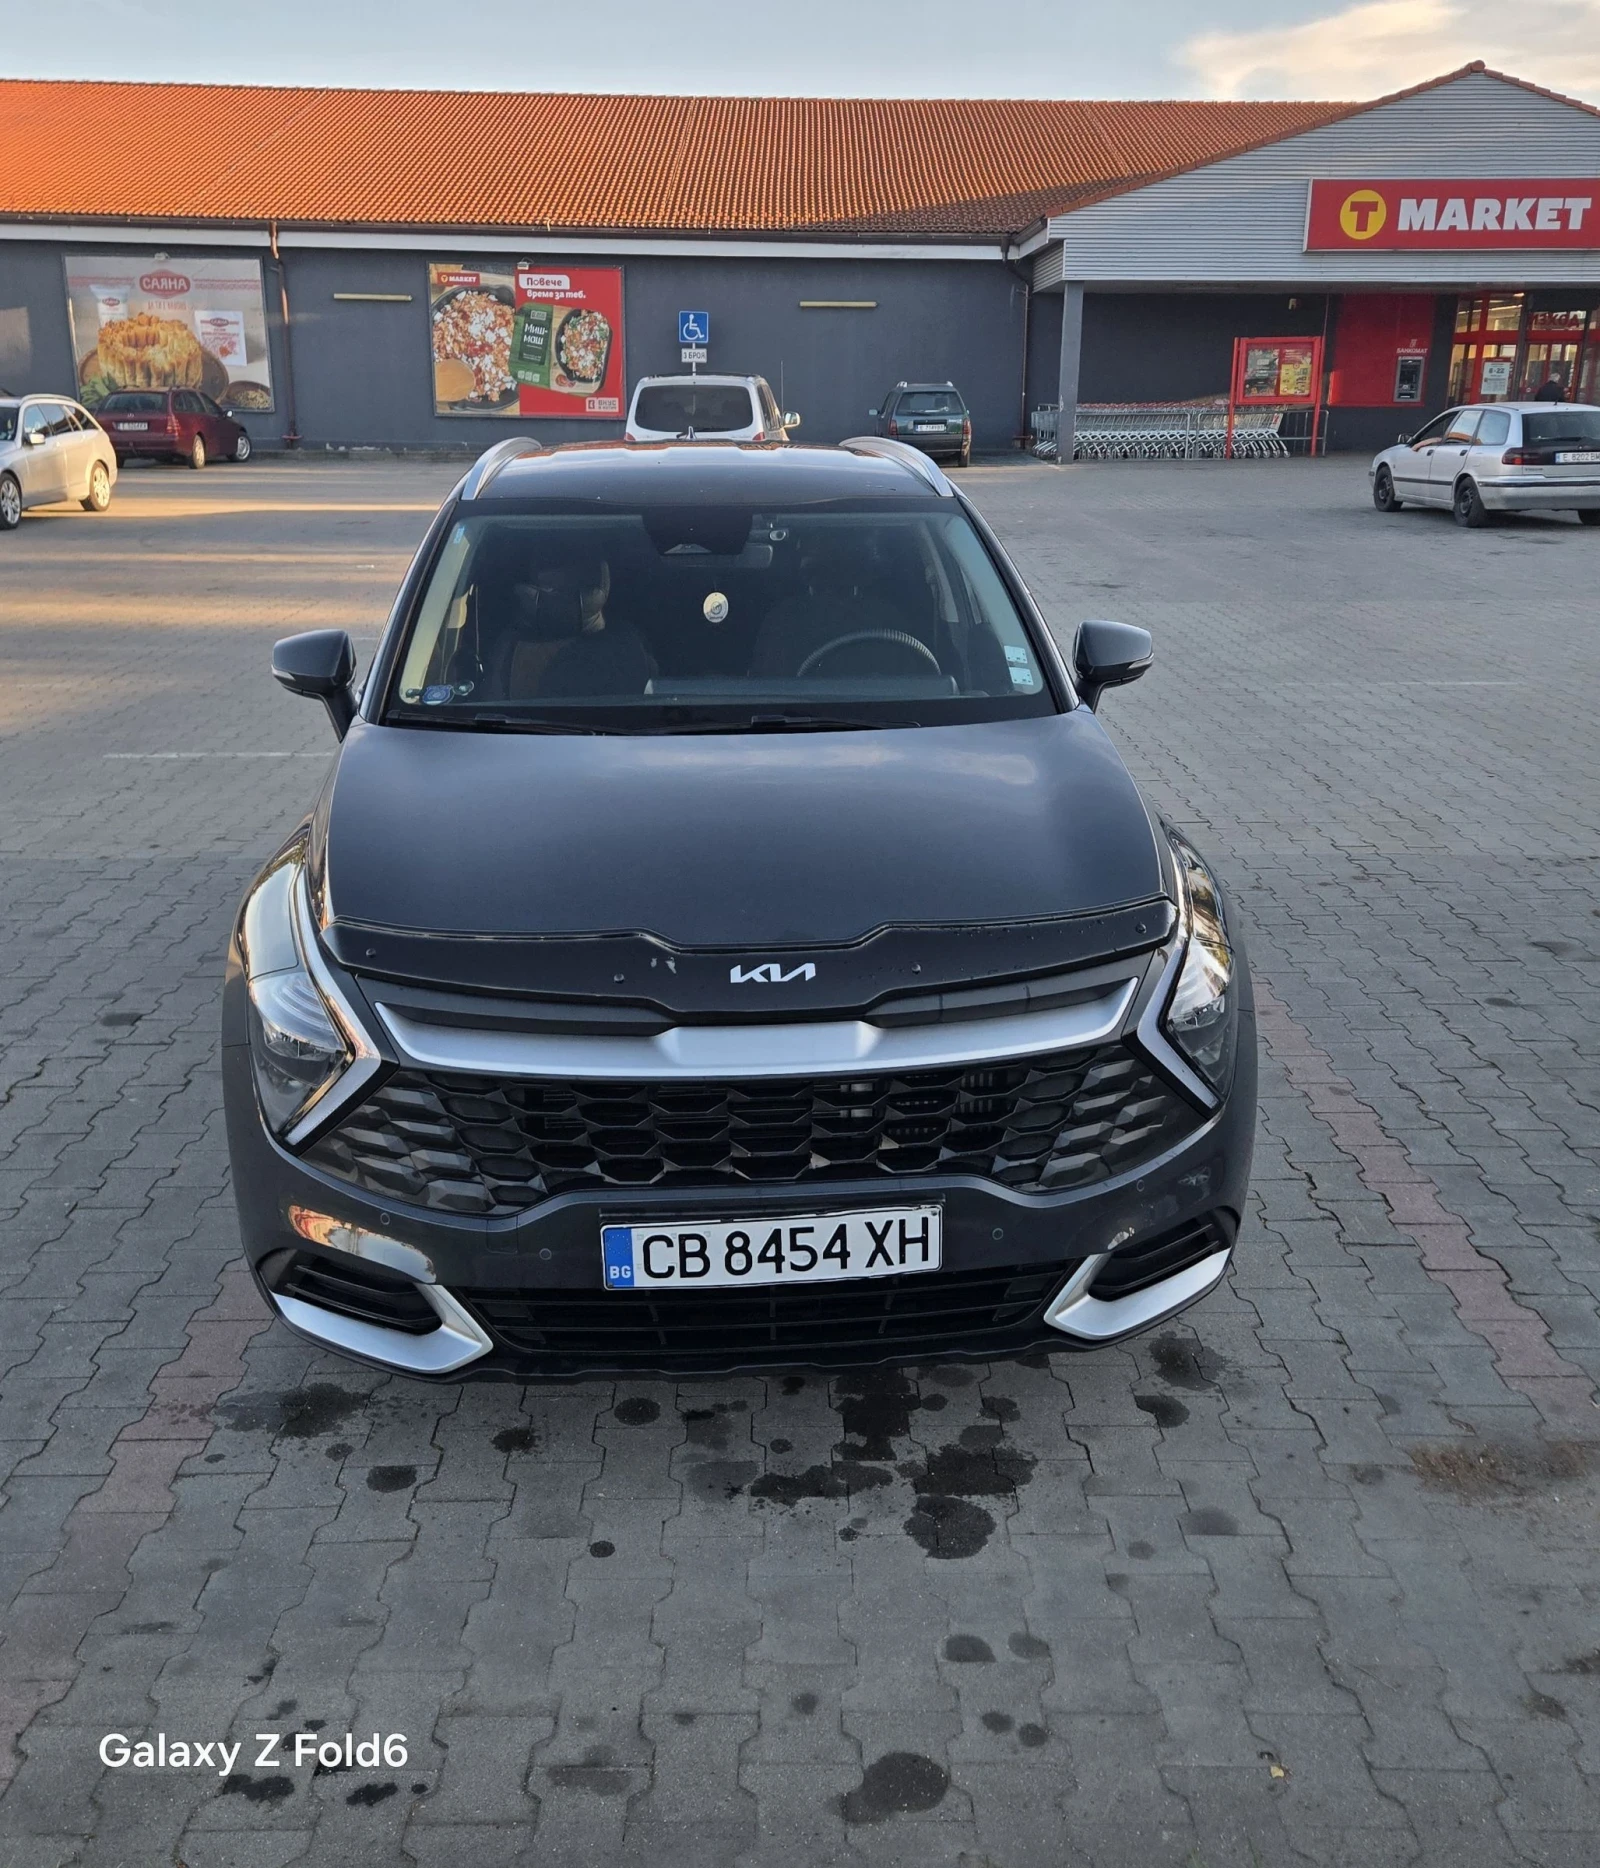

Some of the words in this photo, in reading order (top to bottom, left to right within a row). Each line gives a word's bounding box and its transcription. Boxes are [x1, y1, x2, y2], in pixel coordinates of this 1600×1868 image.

[1350, 201, 1378, 232] T
[1398, 198, 1592, 231] MARKET
[142, 277, 188, 291] САЯНА
[526, 277, 562, 287] Повече
[555, 291, 566, 299] за
[730, 963, 816, 983] KIA
[642, 1233, 711, 1278] CB
[724, 1223, 850, 1276] 8454
[864, 1216, 929, 1268] XH
[609, 1265, 631, 1279] BG
